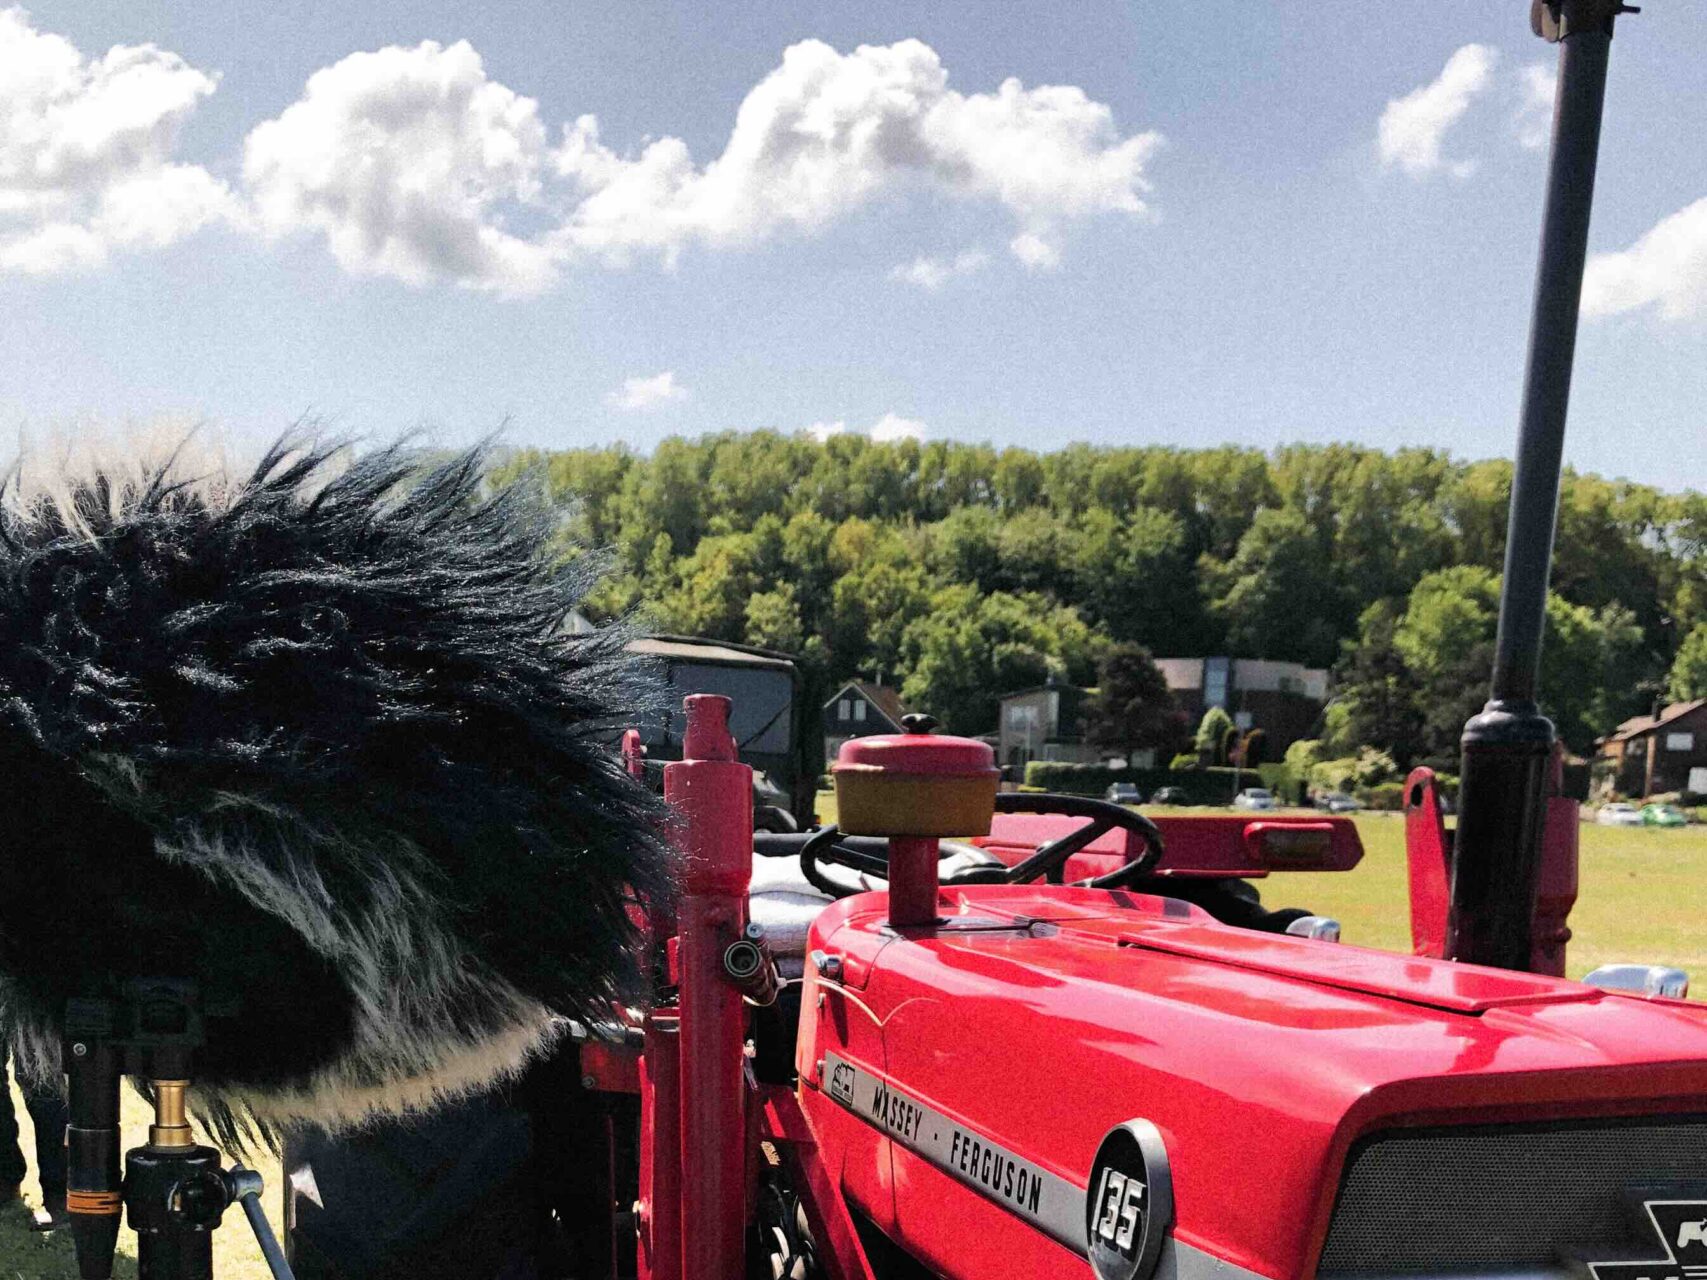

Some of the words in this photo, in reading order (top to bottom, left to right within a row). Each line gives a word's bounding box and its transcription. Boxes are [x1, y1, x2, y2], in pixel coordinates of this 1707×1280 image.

[873, 1086, 922, 1141] MASSEY
[950, 1131, 1042, 1215] FERGUSON
[1093, 1167, 1147, 1250] 135
